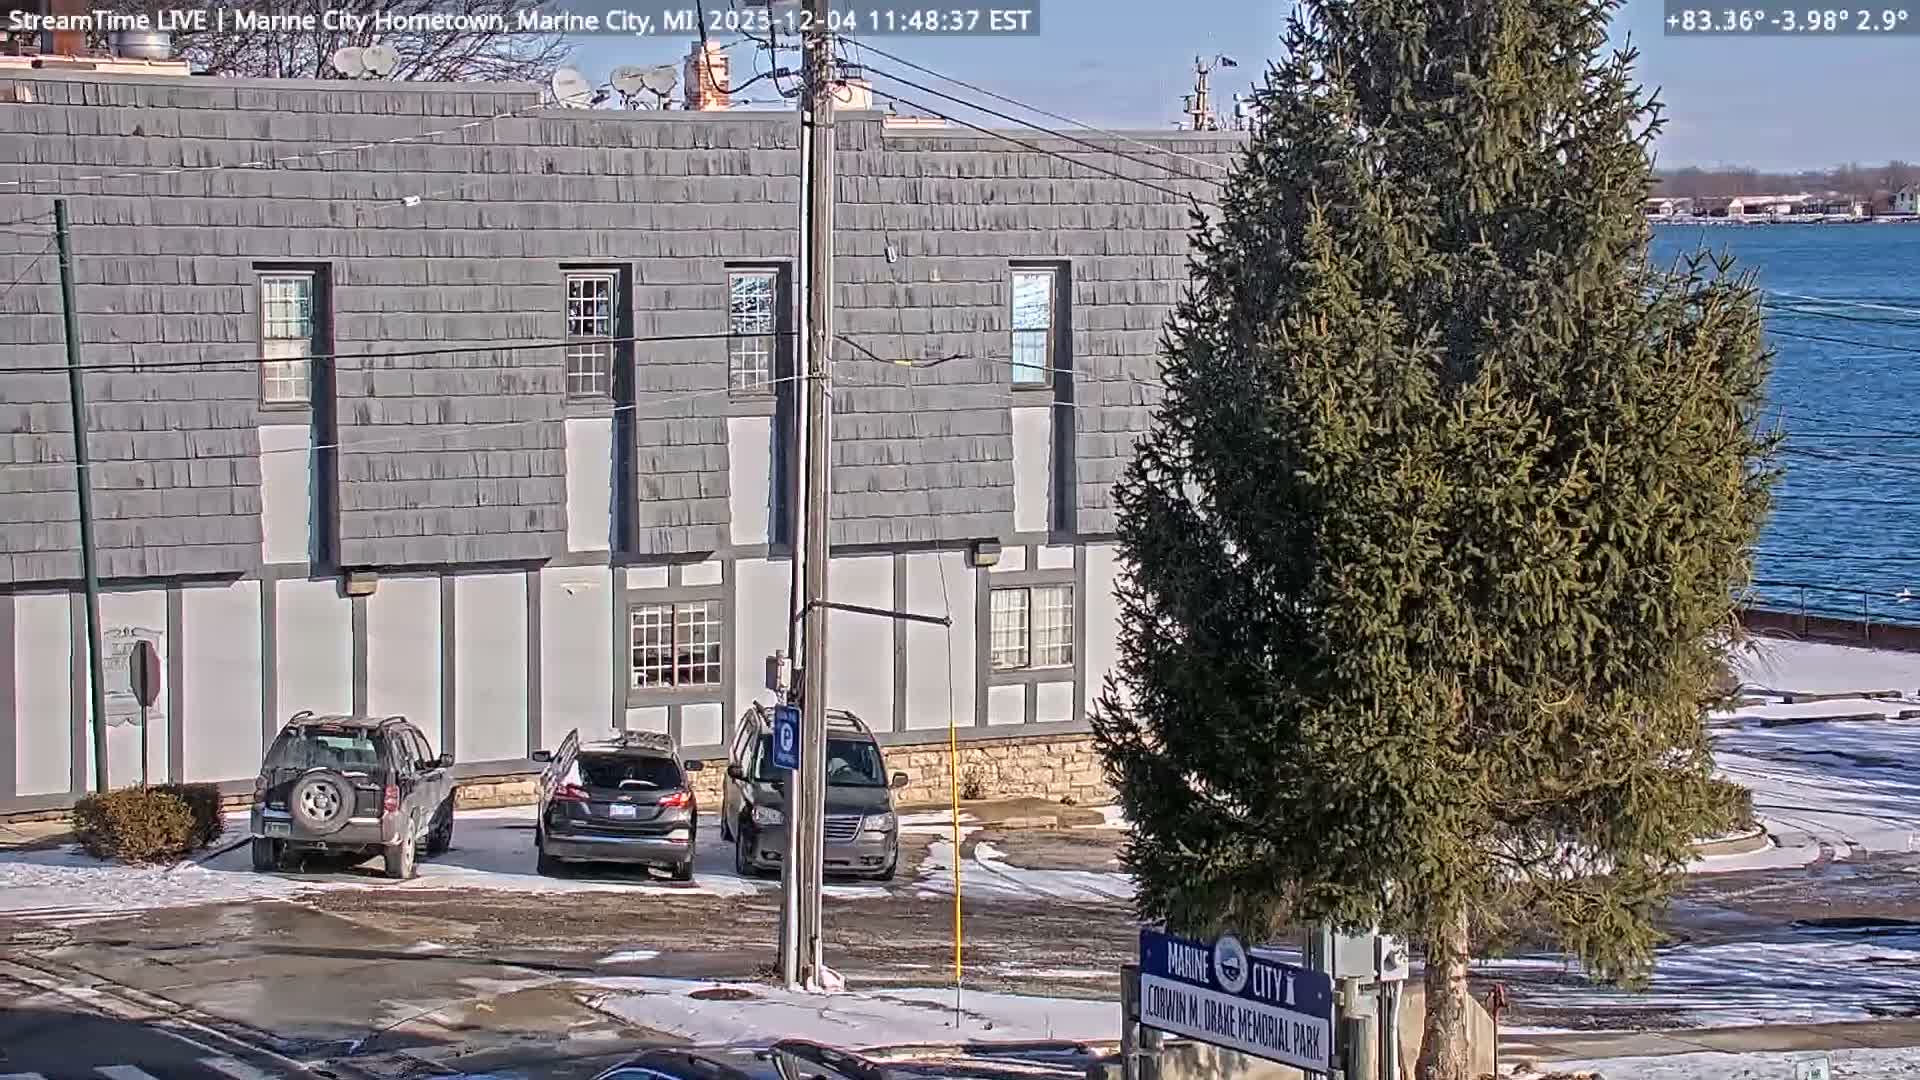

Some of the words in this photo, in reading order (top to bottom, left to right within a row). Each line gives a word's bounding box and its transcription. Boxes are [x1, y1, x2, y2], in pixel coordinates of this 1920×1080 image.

[1167, 941, 1210, 984] MARINE
[1252, 963, 1282, 1001] CITY
[1148, 984, 1187, 1025] CORWIN
[1189, 994, 1202, 1030] M.
[1204, 1000, 1237, 1040] DRAKE
[1238, 1006, 1291, 1053] MEMORIAL
